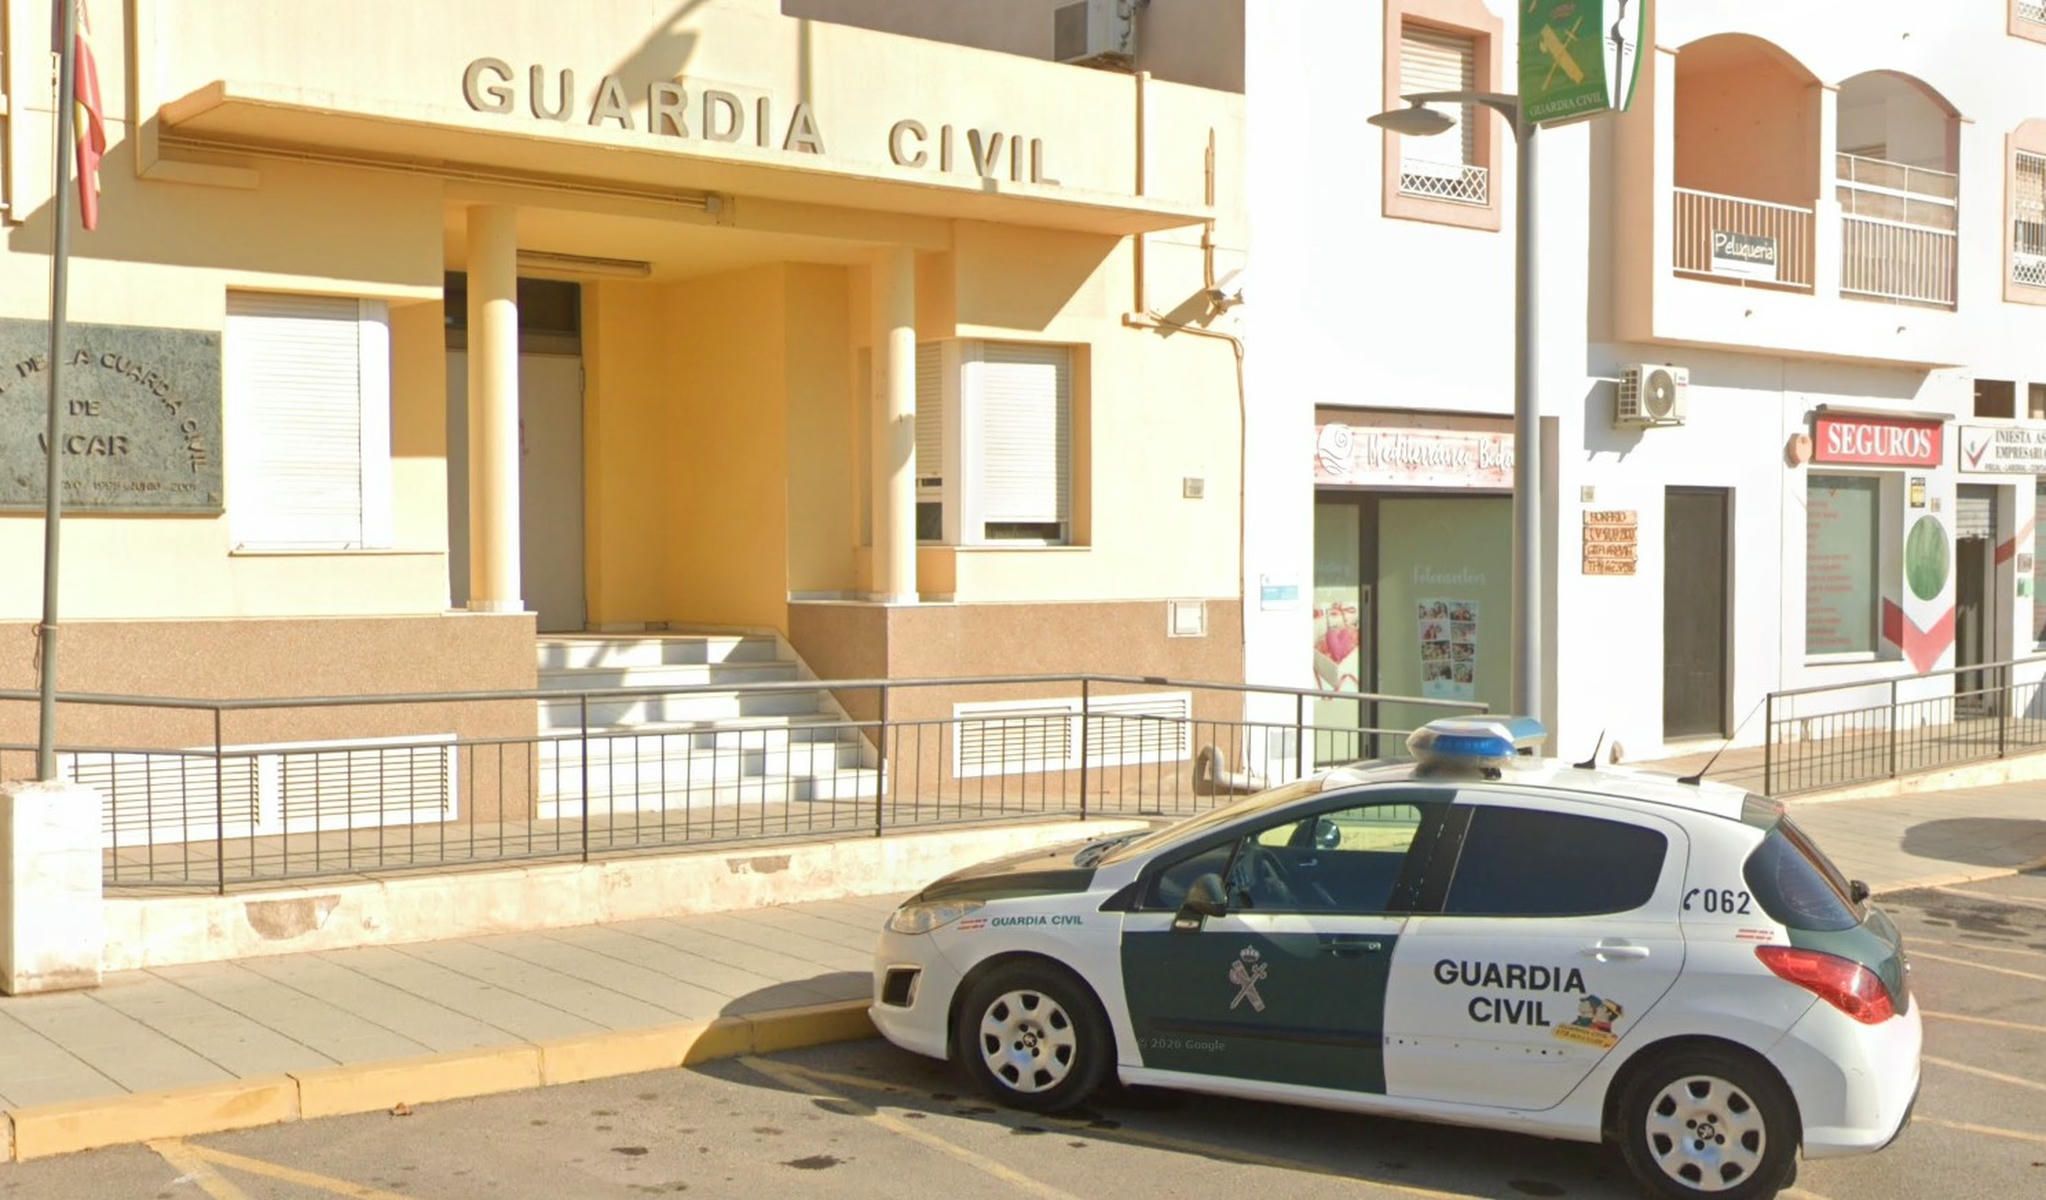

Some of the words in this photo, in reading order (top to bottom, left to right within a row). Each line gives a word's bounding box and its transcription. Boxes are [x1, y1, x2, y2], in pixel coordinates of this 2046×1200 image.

[1530, 99, 1575, 117] GUARDIA
[1575, 91, 1603, 107] CIVIL
[462, 57, 826, 154] GUARDIA
[888, 119, 1061, 187] CIVIL
[69, 399, 100, 417] DE
[1827, 422, 1932, 458] SEGUROS
[1704, 889, 1750, 915] 062
[991, 916, 1047, 927] GUARDIA
[1051, 915, 1083, 925] CIVIL
[1433, 959, 1586, 994] GUARDIA
[1468, 996, 1550, 1027] CIVIL
